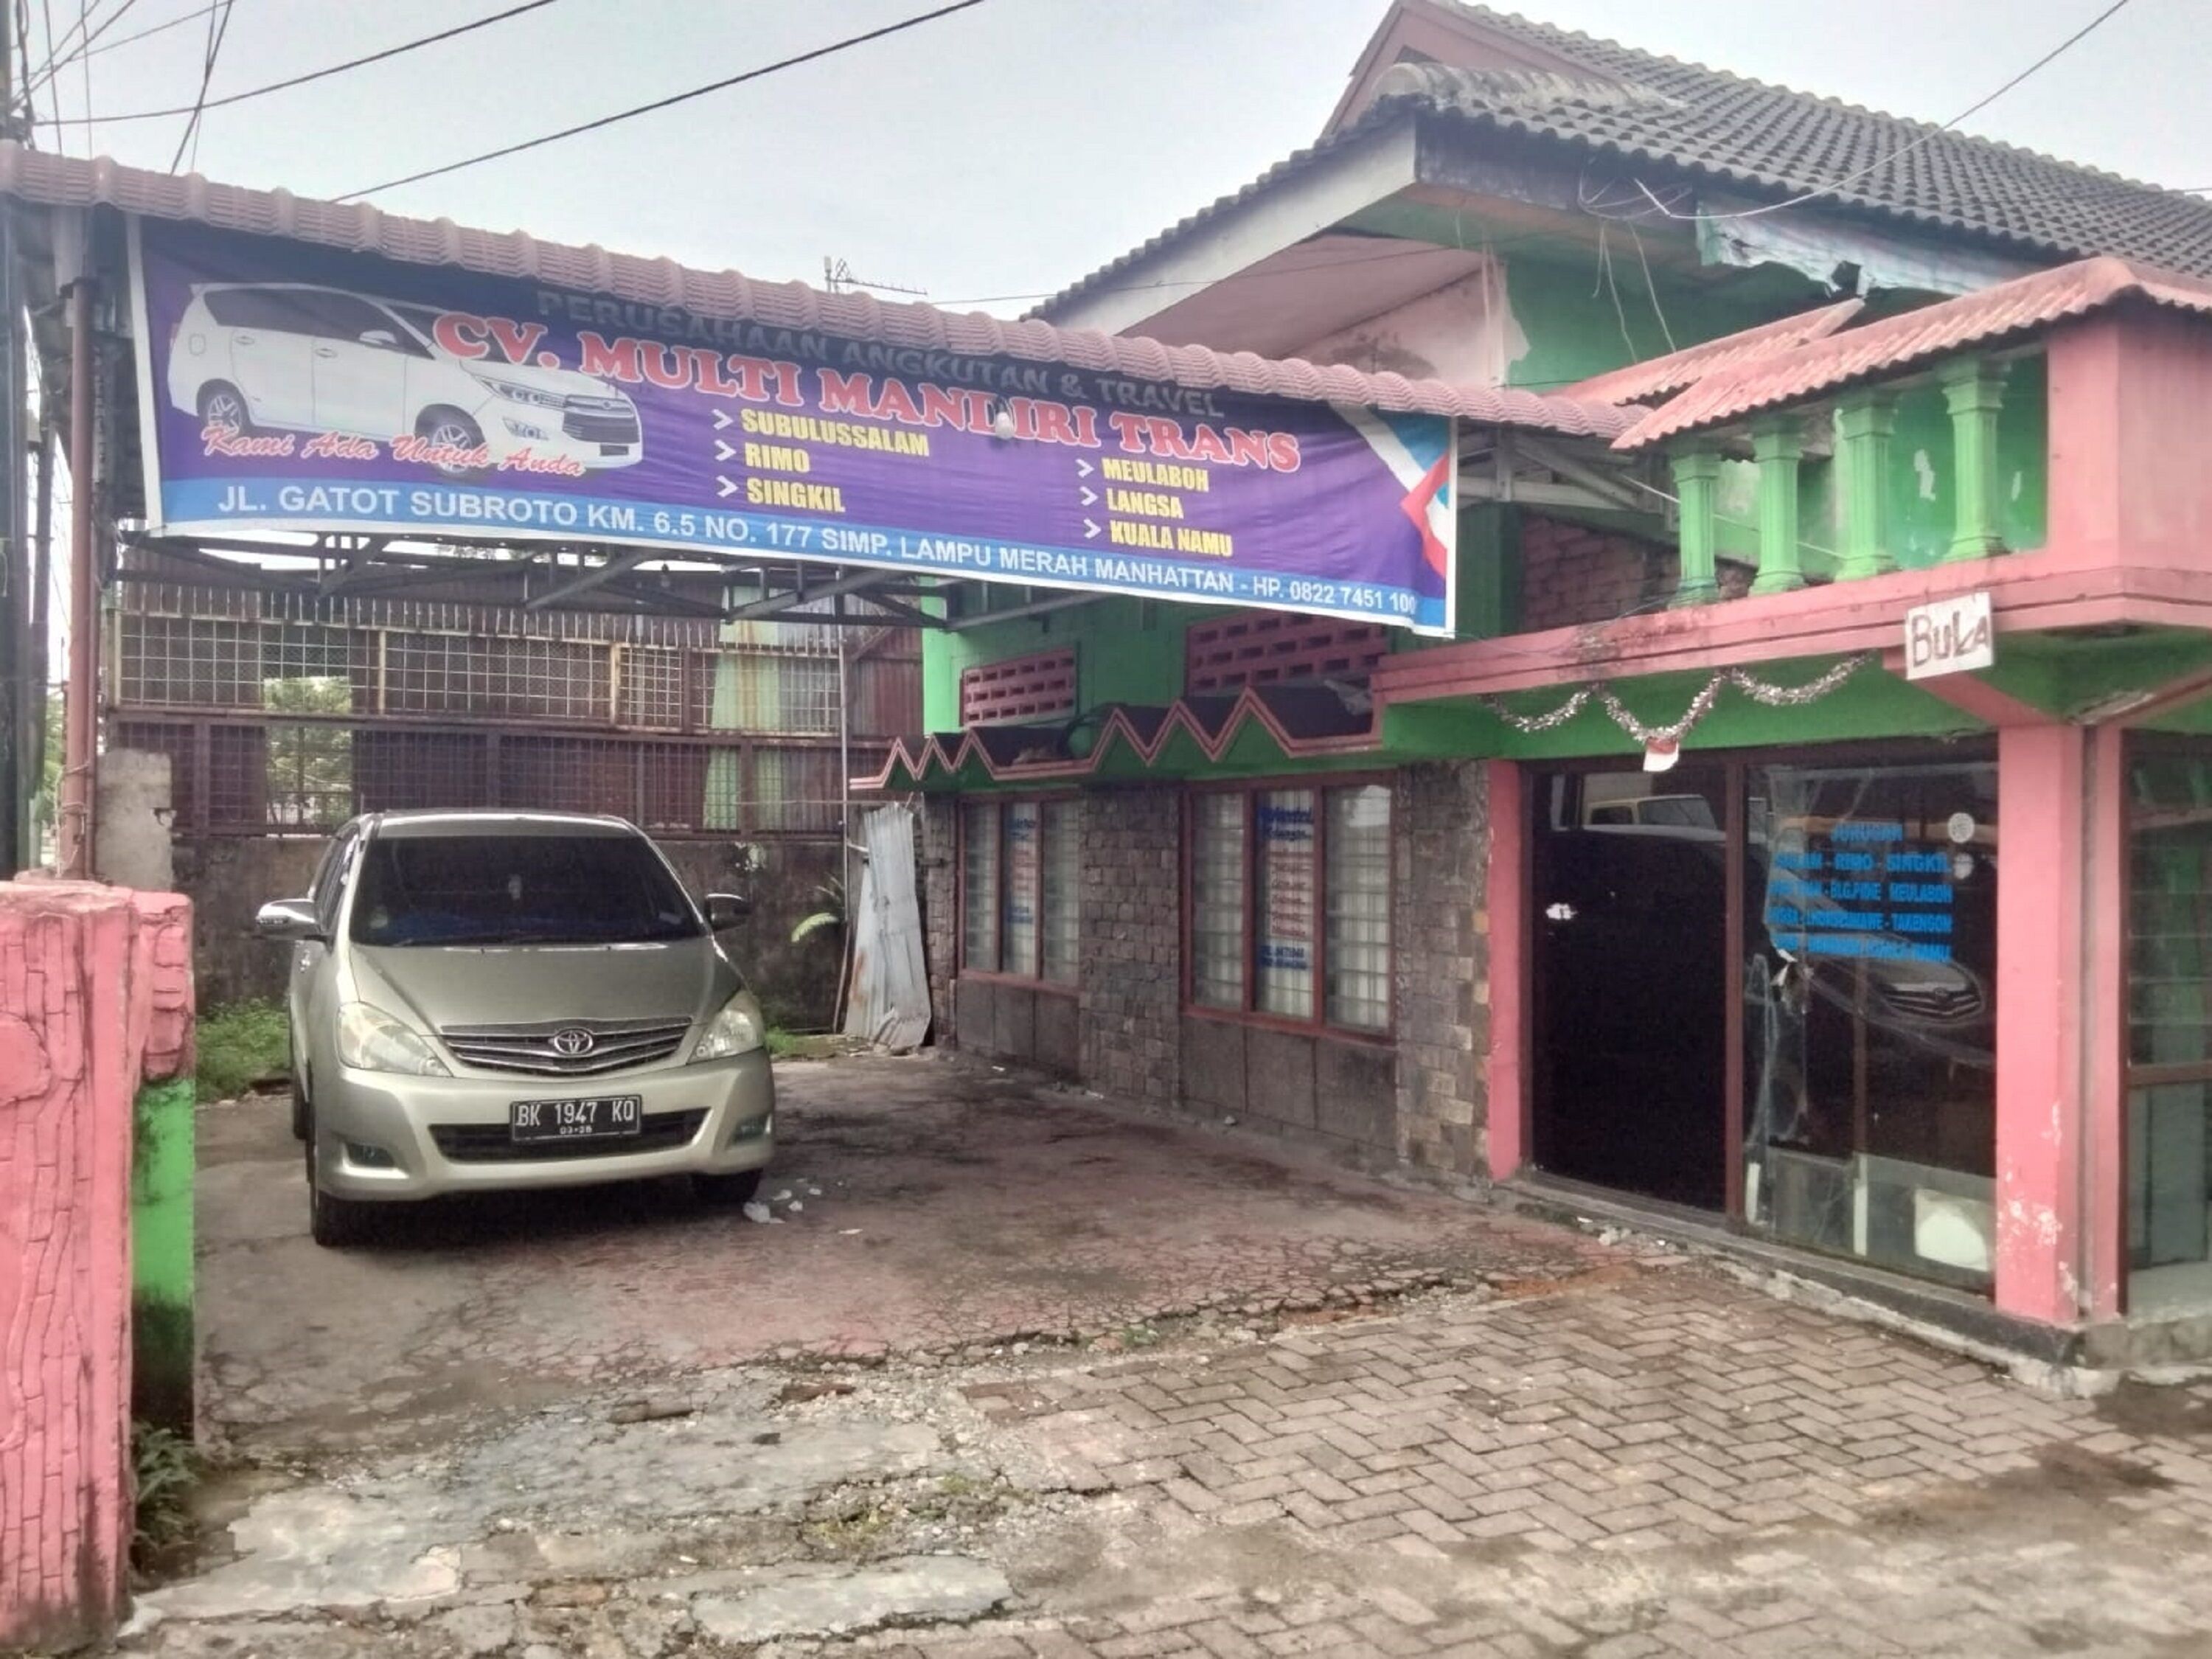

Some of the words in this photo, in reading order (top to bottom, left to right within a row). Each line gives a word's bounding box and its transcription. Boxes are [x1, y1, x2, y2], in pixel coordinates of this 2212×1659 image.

[537, 291, 827, 361] PERUSAHAAN
[842, 342, 1048, 394] ANGKUTAN
[1061, 374, 1088, 399] &
[1096, 377, 1225, 418] TRAVEL
[432, 311, 560, 369] CV.
[577, 330, 805, 407] MULTI
[1110, 411, 1302, 473] TRANS
[740, 408, 931, 457] SUBULUSSALAM
[201, 427, 295, 457] Kami
[301, 431, 380, 460] Ada
[389, 435, 492, 467] Untuk
[498, 444, 586, 478] Anda
[744, 442, 810, 473] RIMO
[1102, 457, 1209, 493] MEULABOH
[746, 478, 846, 512] SINGKIL
[1107, 487, 1184, 519] LANGSA
[218, 485, 266, 513] JL.
[278, 486, 400, 516] GATOT
[410, 492, 578, 526] SUBROTO
[588, 505, 644, 532] KM.
[653, 514, 696, 536] 6.5
[705, 517, 756, 544] NO.
[765, 523, 811, 548] 177
[821, 527, 891, 556] SIMP.
[900, 536, 991, 566] LAMPU
[1000, 546, 1088, 577] MERAH
[1096, 555, 1234, 593] MANHATTAN
[1253, 578, 1284, 598] HP.
[1290, 579, 1335, 605] 0822
[1340, 587, 1382, 610] 7451
[1110, 520, 1174, 549] KUALA
[1176, 528, 1233, 557] NAMU
[516, 1105, 541, 1127] BK
[554, 1101, 598, 1125] 1947
